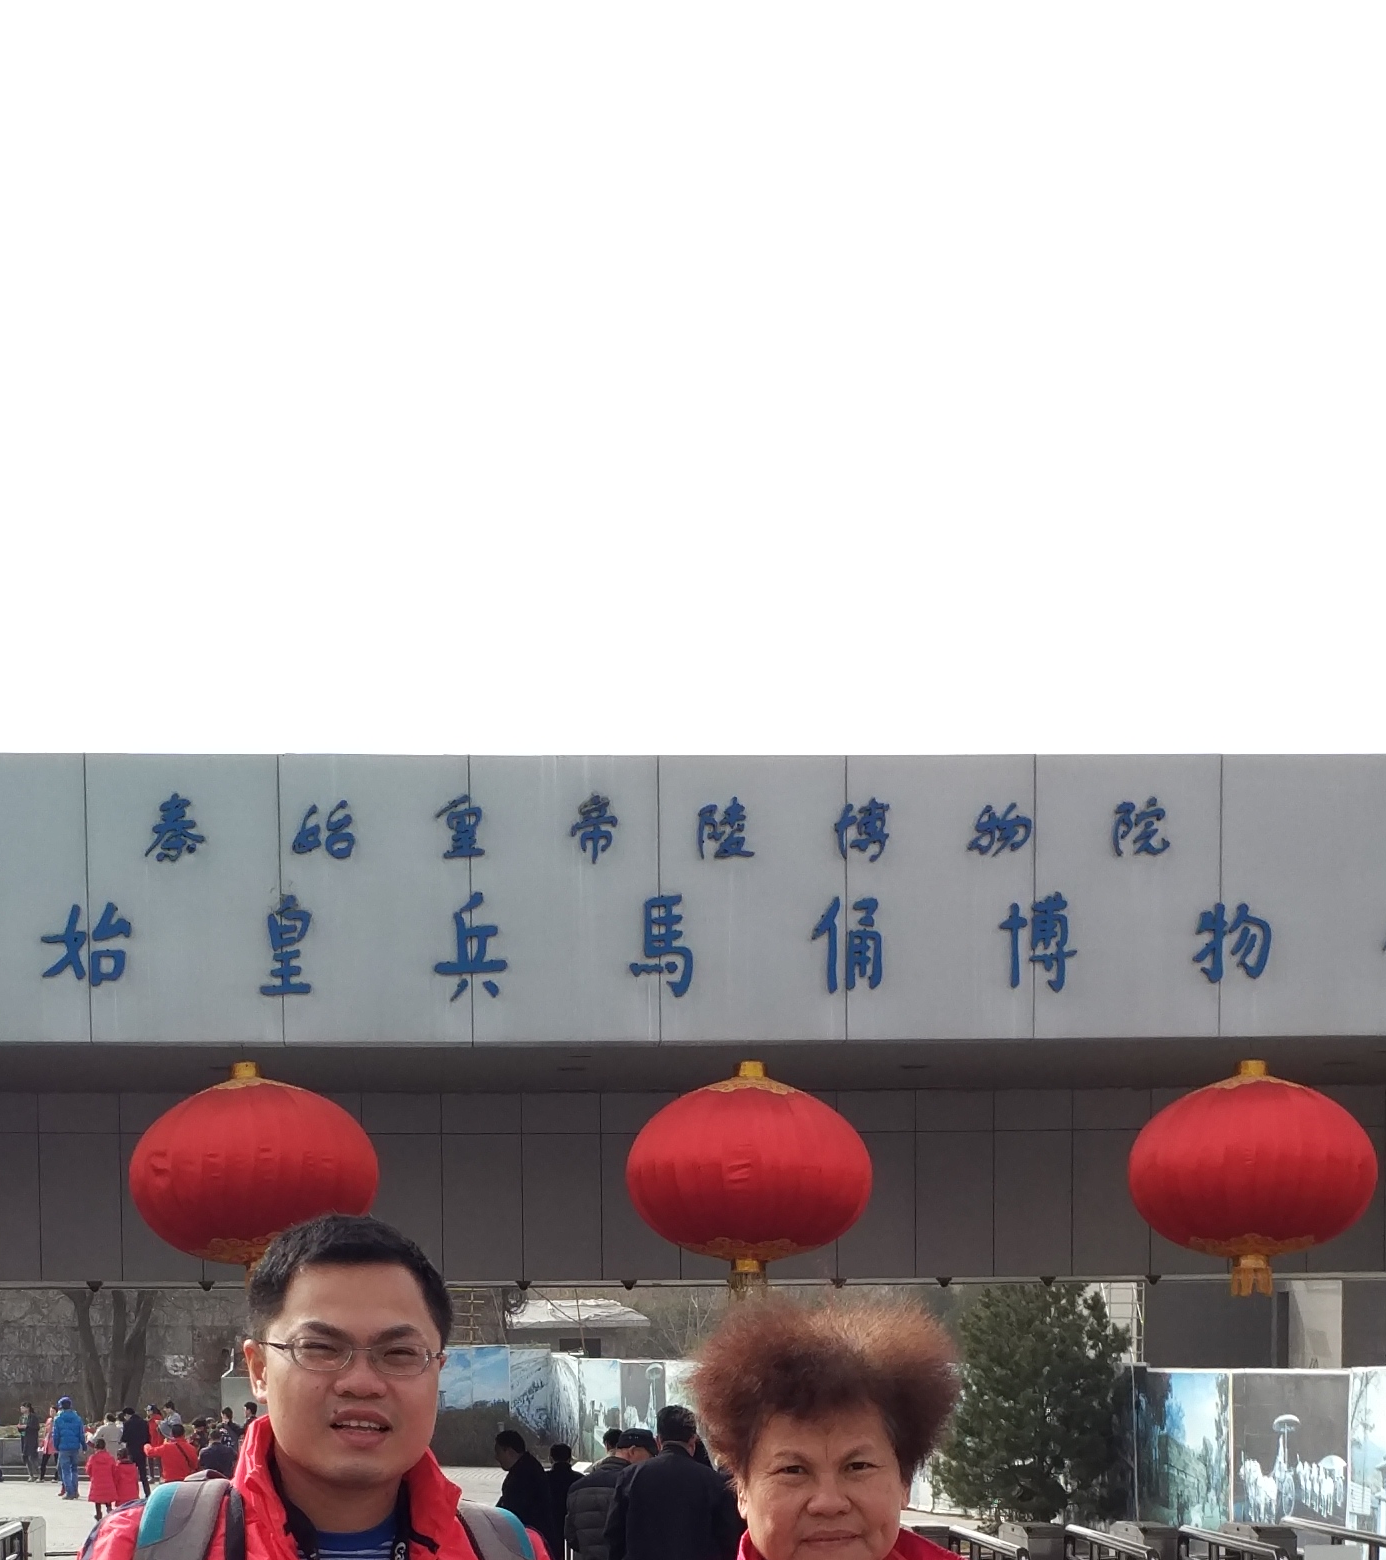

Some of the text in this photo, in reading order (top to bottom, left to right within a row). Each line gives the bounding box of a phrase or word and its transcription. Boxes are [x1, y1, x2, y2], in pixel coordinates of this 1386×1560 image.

[145, 793, 1171, 862] 秦始皇帝陵博物院
